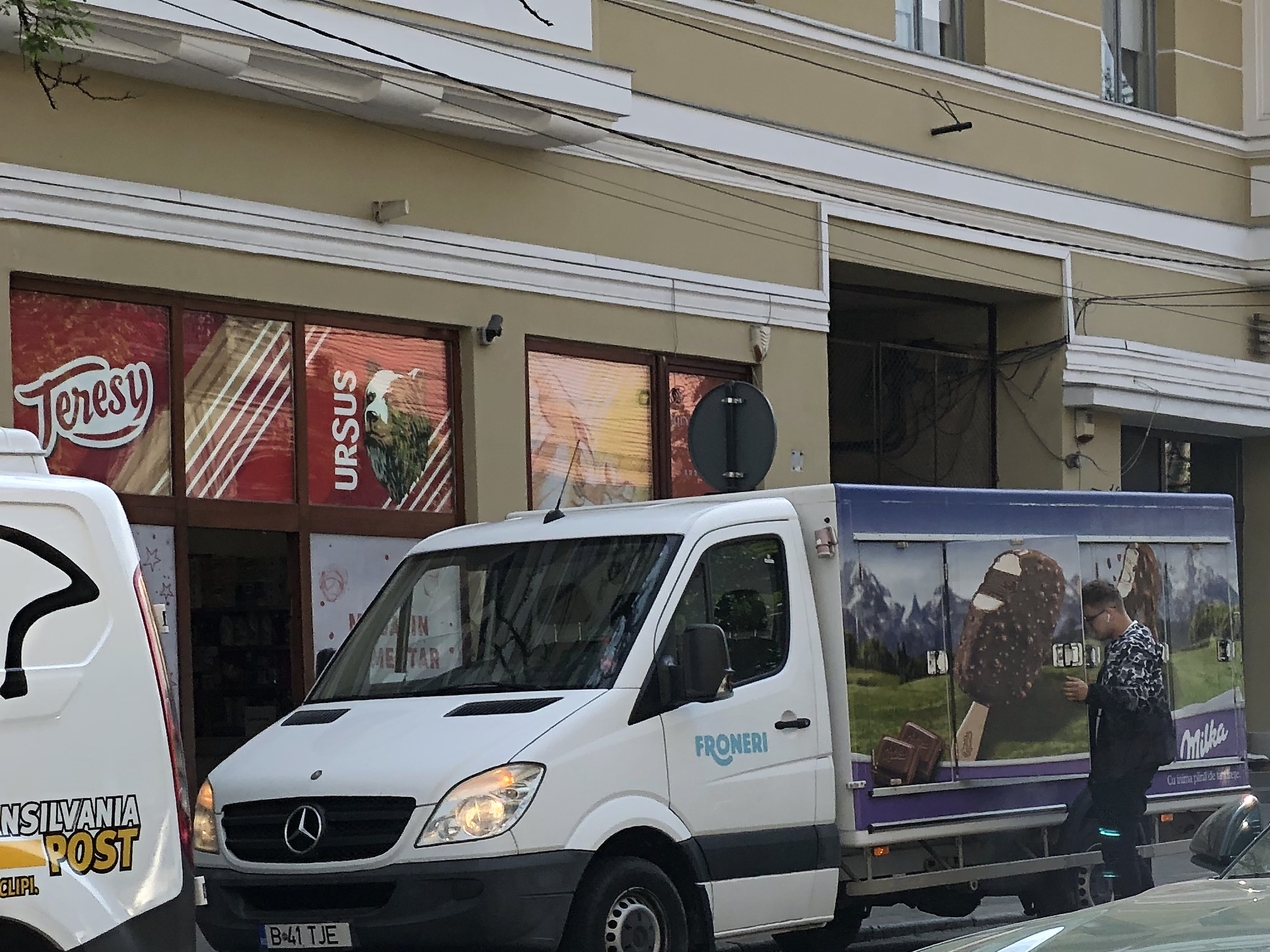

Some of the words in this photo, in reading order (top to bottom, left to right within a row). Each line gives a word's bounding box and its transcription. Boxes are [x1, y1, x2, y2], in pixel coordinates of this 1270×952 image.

[17, 358, 152, 455] Teresy
[332, 370, 360, 490] URSUS
[695, 732, 768, 766] FRONERI
[1180, 719, 1229, 759] Milka
[0, 794, 141, 837] NSILVANIA
[44, 828, 140, 877] POST
[270, 927, 281, 945] B
[288, 926, 302, 945] 41
[307, 925, 338, 944] TJE
